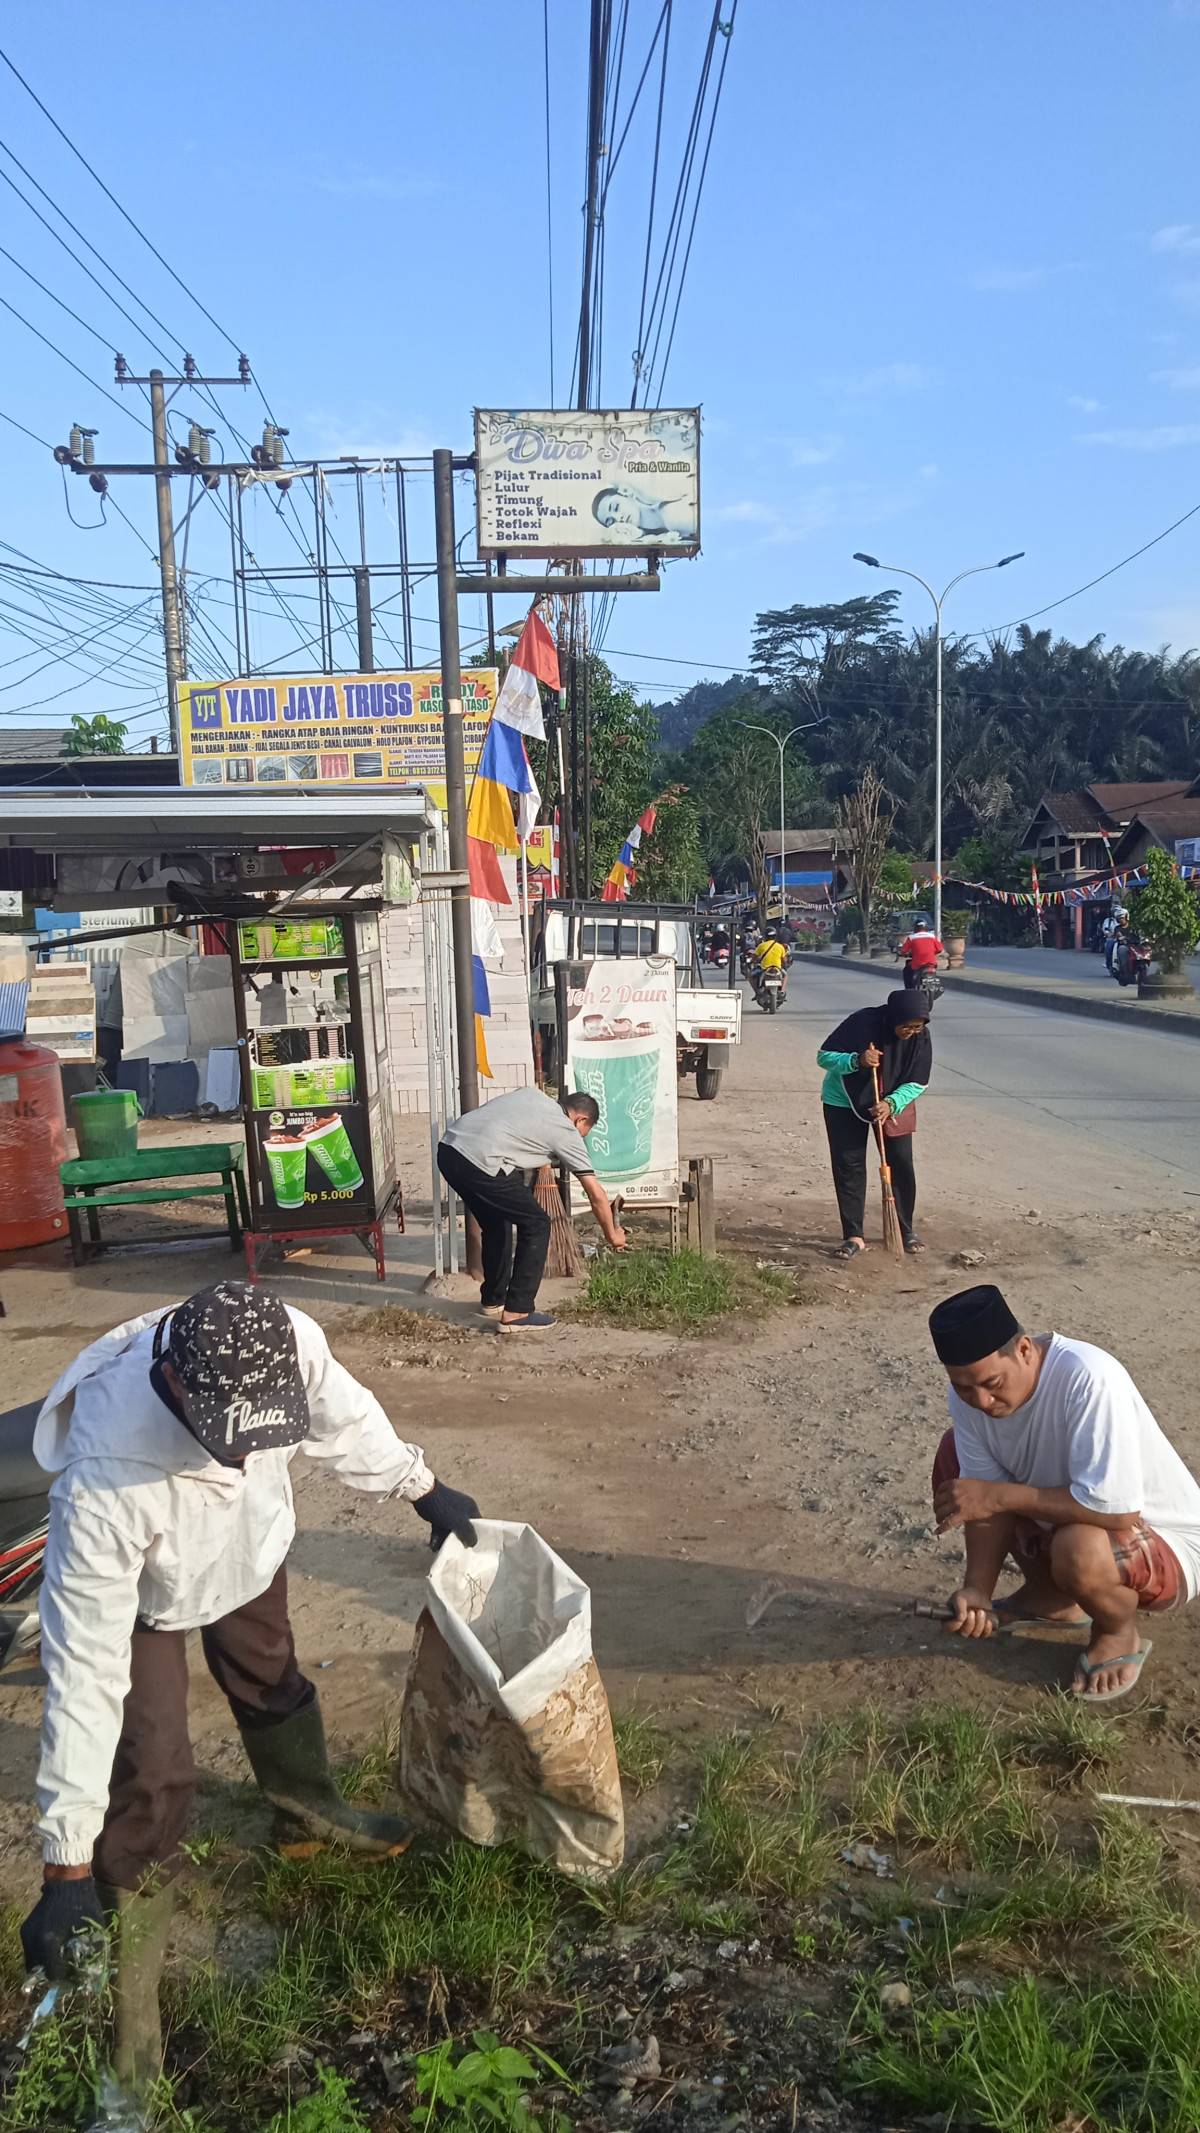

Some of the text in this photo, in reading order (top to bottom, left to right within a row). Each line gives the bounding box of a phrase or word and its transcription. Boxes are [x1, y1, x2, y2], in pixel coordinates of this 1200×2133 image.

[504, 428, 664, 469] Diva Spa
[628, 461, 690, 473] Pria & Wanita
[494, 469, 602, 482] Pijat Tradisional
[495, 483, 530, 493] Lulur
[495, 495, 544, 506] Timung
[496, 506, 578, 518] Totok Wajah
[496, 518, 542, 529] Reflexi
[496, 531, 539, 541] Bekam
[431, 683, 476, 698] RDY
[194, 694, 217, 722] YJT
[224, 682, 413, 723] YADI JAYA TRUSS
[466, 698, 489, 711] TASO
[190, 730, 251, 742] MENGERJAKAN
[261, 729, 296, 740] RANGKA
[297, 728, 318, 738] ATAP
[320, 726, 341, 737] BAJA
[341, 725, 374, 736] RINGAN
[380, 723, 429, 734] KUNTRUKSI
[191, 744, 204, 754] JUAL
[205, 743, 225, 753] BAHAN
[228, 742, 249, 753] BAHAN
[254, 741, 268, 752] JUAL
[269, 741, 290, 752] SEGALA
[290, 740, 306, 751] JENIS
[306, 739, 321, 750] BESI
[324, 738, 342, 749] CANAL
[343, 737, 373, 748] GALVALUM
[376, 737, 391, 747] HOLO
[392, 735, 413, 746] PLAFON
[417, 734, 441, 746] GYPSUM
[390, 767, 409, 776] TELPON
[567, 984, 668, 1007] Teh 2 Daun
[286, 1116, 317, 1126] JUMBO SIZE
[640, 1185, 658, 1193] FOOD
[303, 1189, 354, 1204] Rp 5.000
